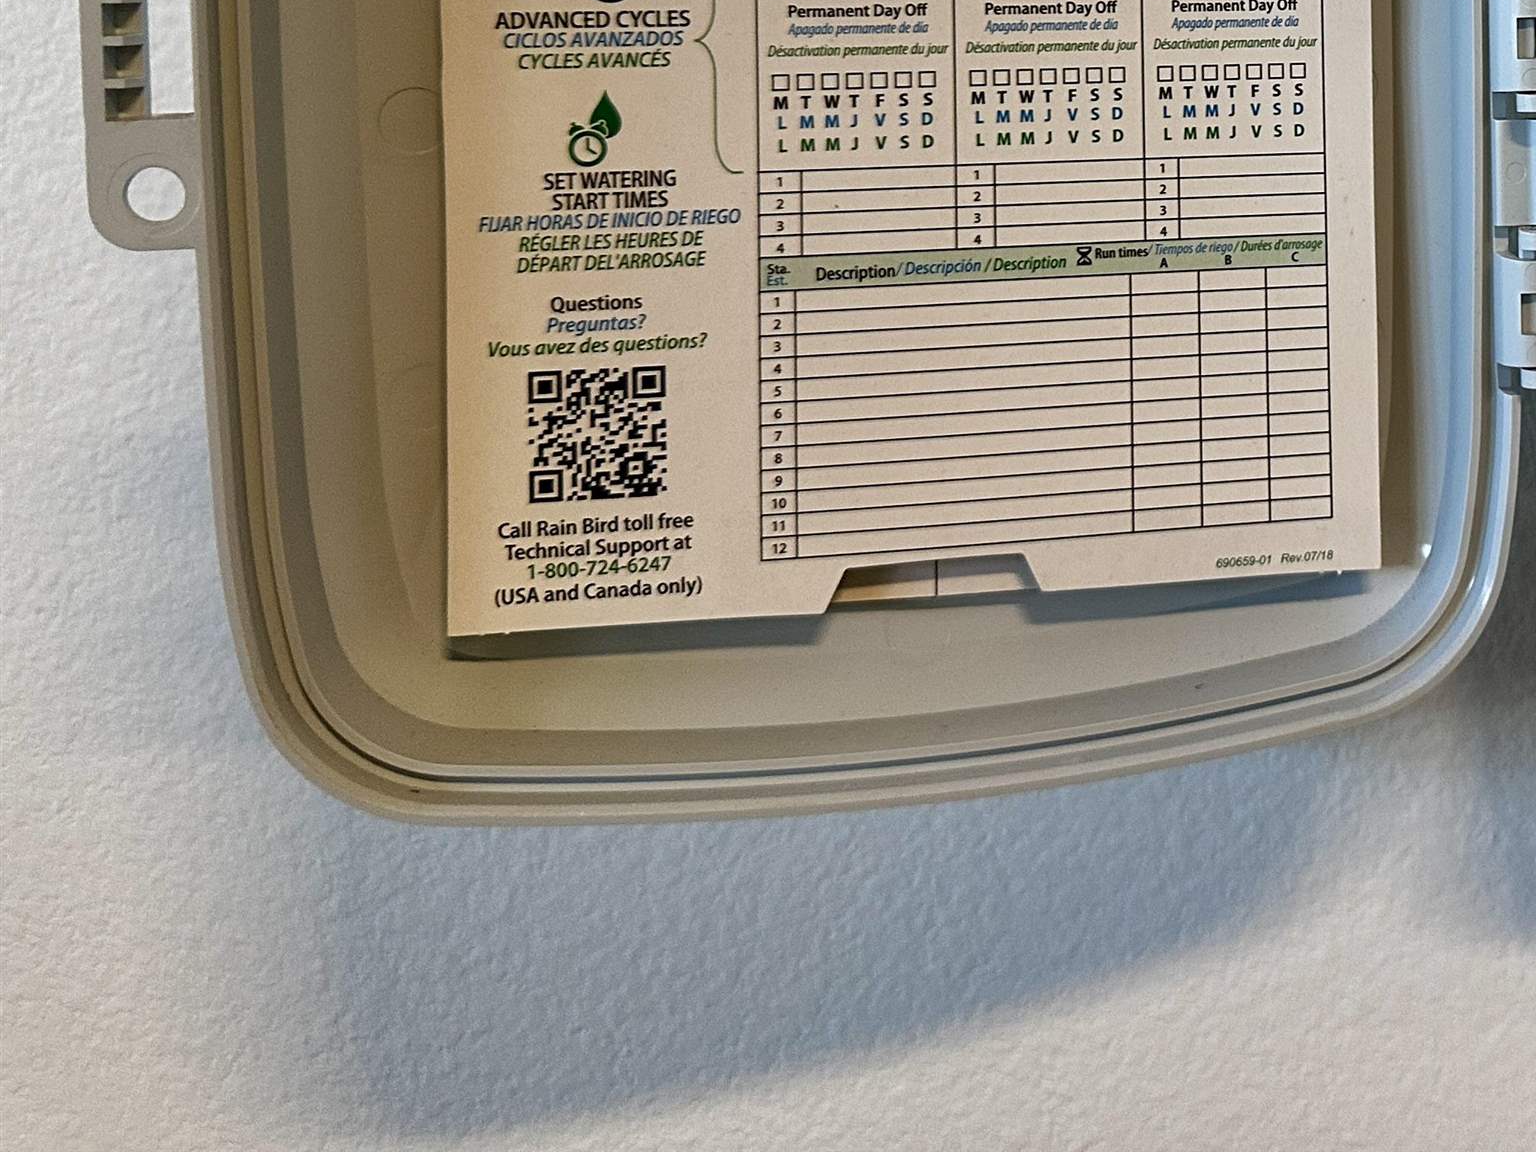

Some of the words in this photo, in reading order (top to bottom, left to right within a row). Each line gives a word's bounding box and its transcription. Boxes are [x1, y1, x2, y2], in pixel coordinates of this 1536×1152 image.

[788, 5, 870, 19] Permanent
[874, 4, 901, 20] Day
[905, 3, 929, 17] Off
[985, 2, 1062, 16] Permanent
[1066, 1, 1091, 17] Day
[1096, 0, 1118, 14] Off
[1171, 0, 1246, 13] Permanent
[1249, 0, 1274, 14] Day
[496, 11, 610, 30] ADVANCED
[616, 10, 691, 28] CYCLES
[1171, 18, 1214, 30] Apagado
[1215, 17, 1270, 29] permanente
[1271, 16, 1283, 27] de
[504, 32, 567, 49] CICLOS
[571, 31, 684, 48] AVANZADOS
[519, 53, 583, 70] CYCLES
[587, 49, 672, 69] AVANCÉS
[544, 173, 577, 191] SET
[581, 170, 677, 189] WATERING
[552, 192, 608, 211] START
[614, 191, 669, 208] TIMES
[479, 216, 523, 233] FIJAR
[527, 214, 583, 231] HORAS
[587, 213, 609, 229] DE
[612, 212, 663, 228] INICIO
[667, 210, 689, 226] DE
[692, 209, 742, 225] RIEGO
[519, 234, 581, 253] RÉGLER
[584, 234, 612, 250] LES
[615, 232, 678, 249] HEURES
[682, 231, 705, 246] DE
[1095, 247, 1117, 260] Run
[1155, 244, 1194, 256] Tiempos
[1195, 243, 1207, 254] de
[1209, 241, 1234, 255] riego
[1240, 240, 1273, 252] Durées
[517, 254, 582, 274] DÉPART
[905, 259, 982, 278] Descripción
[1160, 258, 1169, 268] A
[1225, 254, 1233, 265] B
[1291, 252, 1300, 262] C
[767, 263, 791, 276] Sta.
[767, 275, 788, 286] Est.
[550, 295, 643, 313] Questions
[774, 297, 780, 308] 1
[547, 314, 647, 336] Preguntas?
[773, 320, 782, 330] 2
[488, 342, 530, 358] Vous
[535, 342, 576, 356] avez
[580, 338, 608, 353] des
[613, 333, 708, 355] questions?
[774, 342, 782, 353] 3
[774, 364, 782, 375] 4
[774, 386, 782, 397] 5
[774, 408, 783, 420] 6
[774, 431, 783, 442] 7
[774, 453, 783, 465] 8
[775, 476, 783, 488] 9
[772, 498, 788, 510] 10
[497, 522, 532, 540] Call
[537, 520, 577, 537] Rain
[583, 518, 619, 535] Bird
[623, 514, 653, 533] toll
[658, 513, 695, 530] free
[772, 520, 787, 532] 11
[504, 541, 591, 561] Technical
[595, 537, 669, 558] Support
[673, 536, 693, 551] at
[772, 543, 788, 555] 12
[527, 557, 673, 580] 1-800-724-6247
[1216, 555, 1273, 569] 690659-01
[494, 587, 540, 608] (USA
[544, 586, 580, 603] and
[584, 582, 651, 600] Canada
[657, 576, 703, 596] only)
